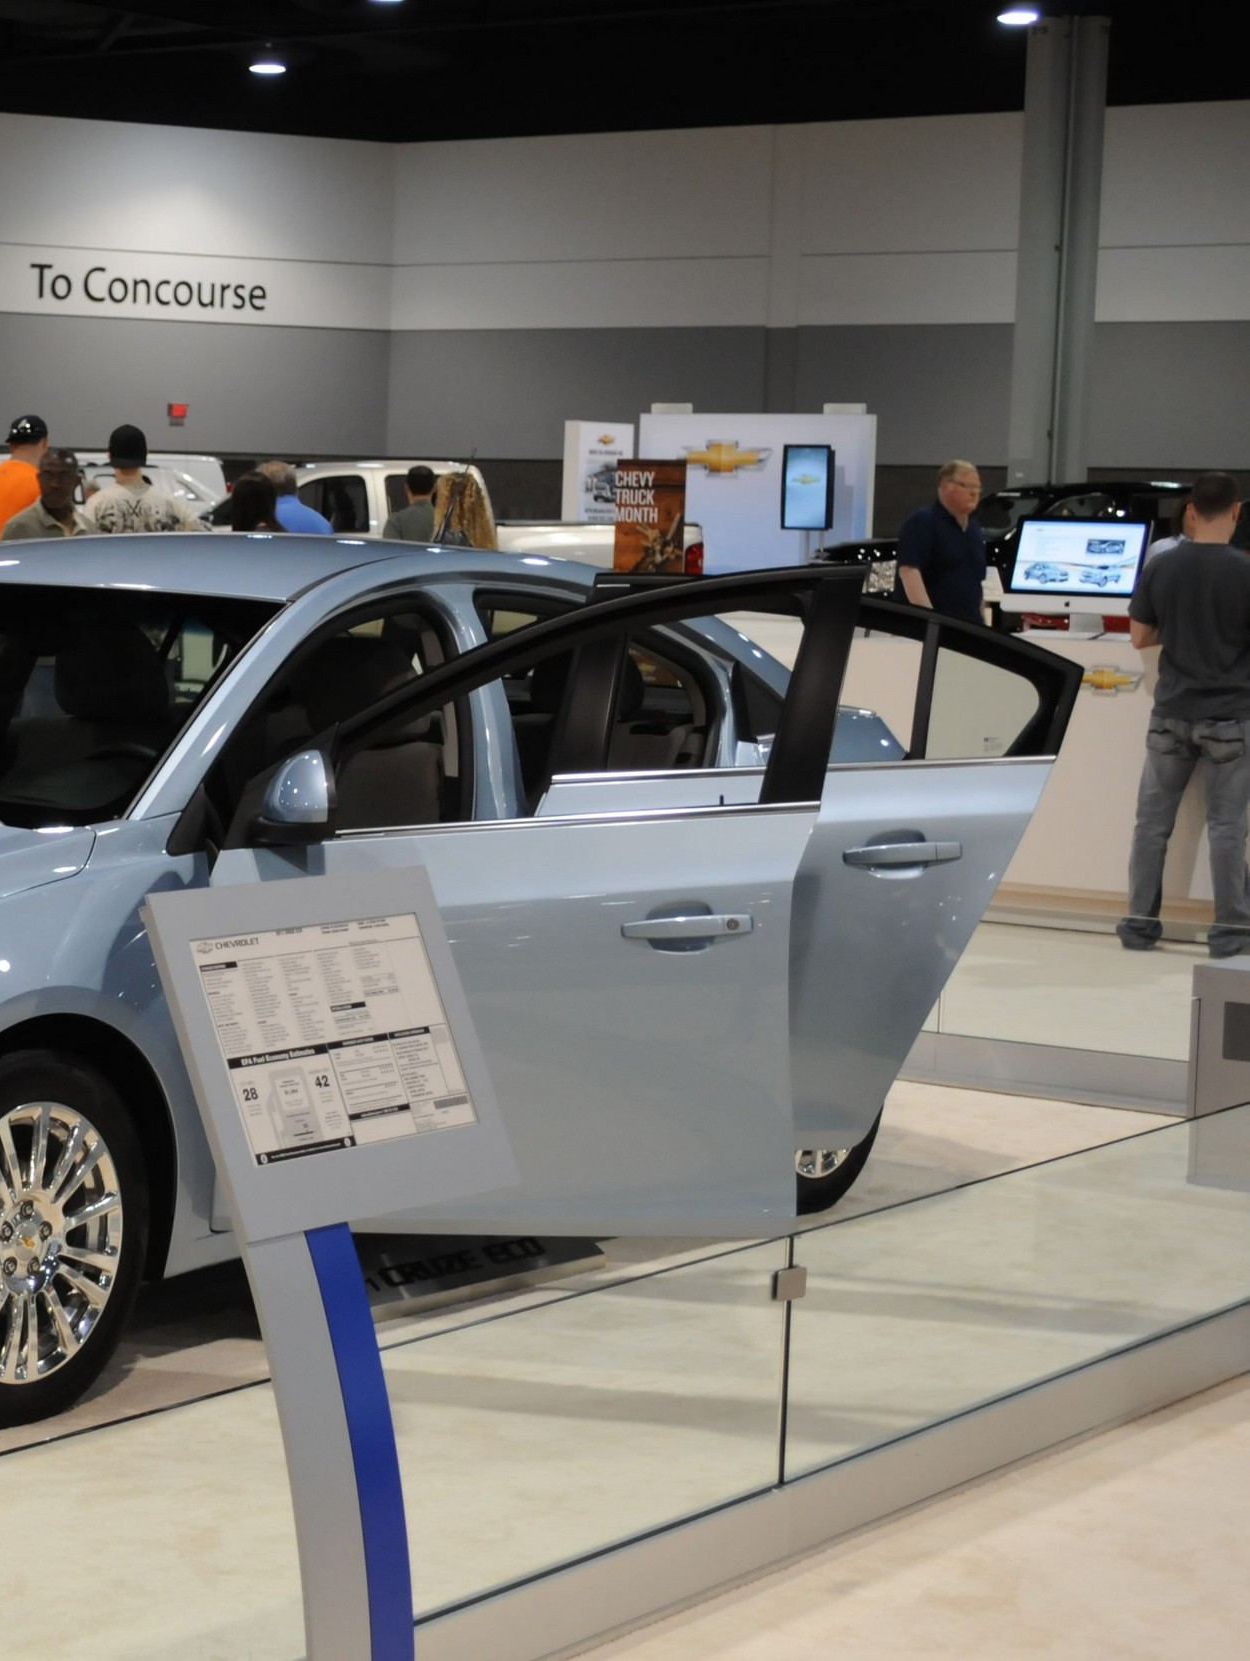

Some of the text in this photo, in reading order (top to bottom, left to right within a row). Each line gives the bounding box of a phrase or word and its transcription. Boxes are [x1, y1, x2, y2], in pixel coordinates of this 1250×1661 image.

[30, 263, 267, 311] To Concourse
[615, 470, 655, 488] CHEVY
[615, 488, 655, 505] TRUCK
[614, 506, 659, 524] MONTH
[215, 937, 260, 950] CHEVROLET
[315, 1075, 330, 1088] 42
[242, 1087, 258, 1101] 28
[377, 1250, 484, 1288] CRUZE
